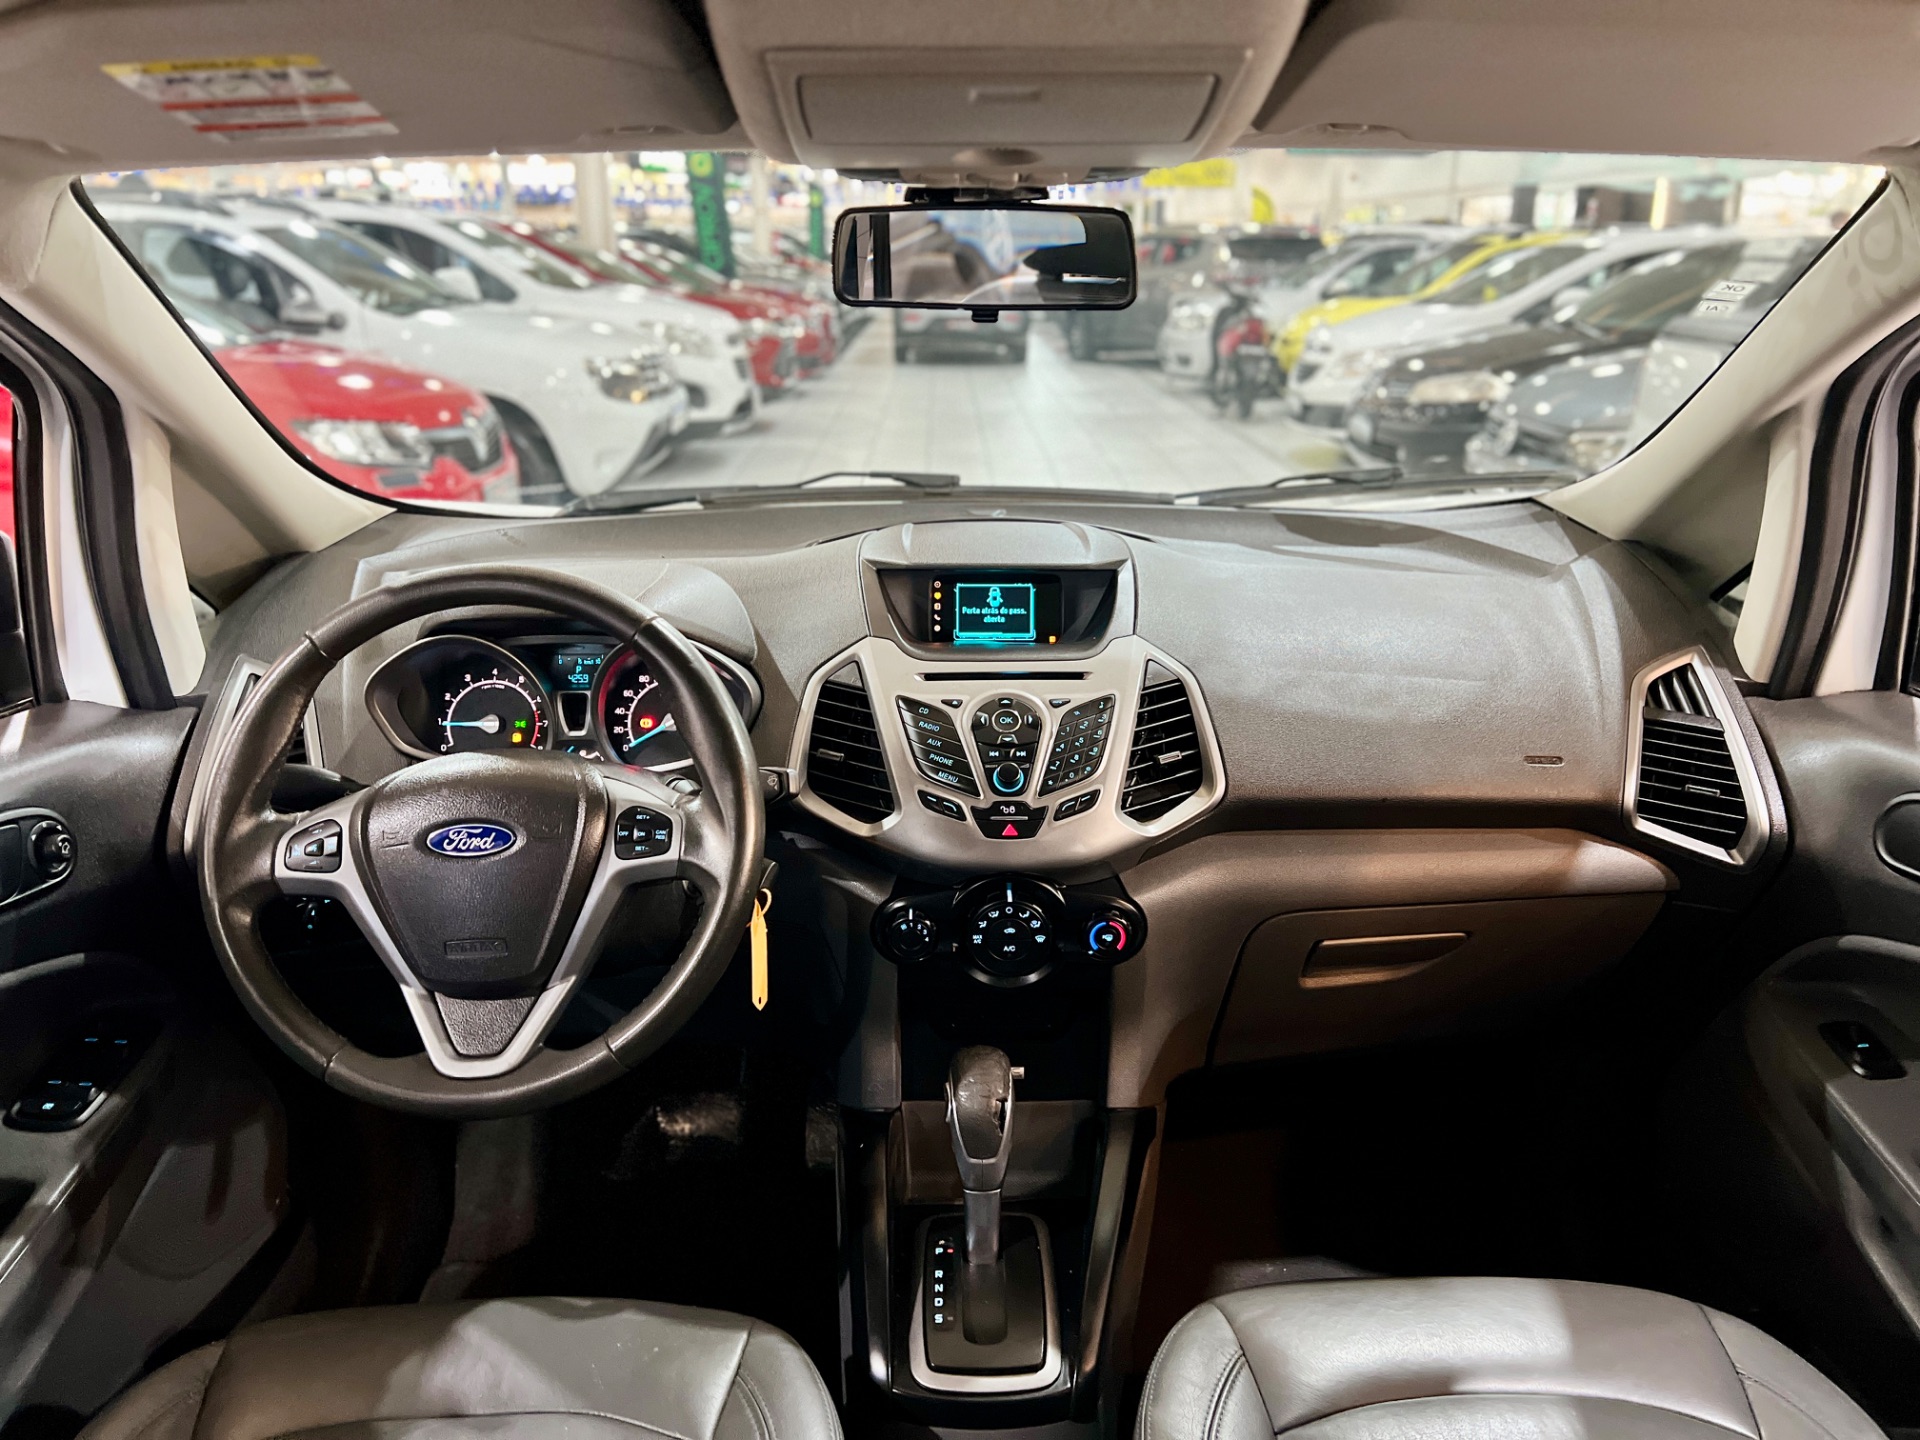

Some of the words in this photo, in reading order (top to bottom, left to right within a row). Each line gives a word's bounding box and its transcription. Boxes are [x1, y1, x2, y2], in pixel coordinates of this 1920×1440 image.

[491, 668, 498, 676] 4
[464, 674, 472, 682] 3
[638, 675, 650, 683] 80
[444, 692, 452, 701] 2
[623, 689, 634, 698] 60
[614, 707, 626, 715] 40
[918, 706, 930, 715] CD
[542, 720, 549, 728] 7
[999, 716, 1014, 724] OK
[613, 726, 625, 734] 20
[918, 721, 940, 733] RADIO
[926, 738, 943, 748] AUX
[440, 744, 448, 752] 0
[622, 744, 630, 752] 0
[928, 753, 954, 767] PHONE
[937, 770, 959, 783] MENU
[442, 828, 497, 851] Ford
[934, 1247, 944, 1255] P
[934, 1270, 944, 1279] R
[934, 1283, 944, 1293] N
[934, 1297, 944, 1307] D
[934, 1313, 944, 1324] S
